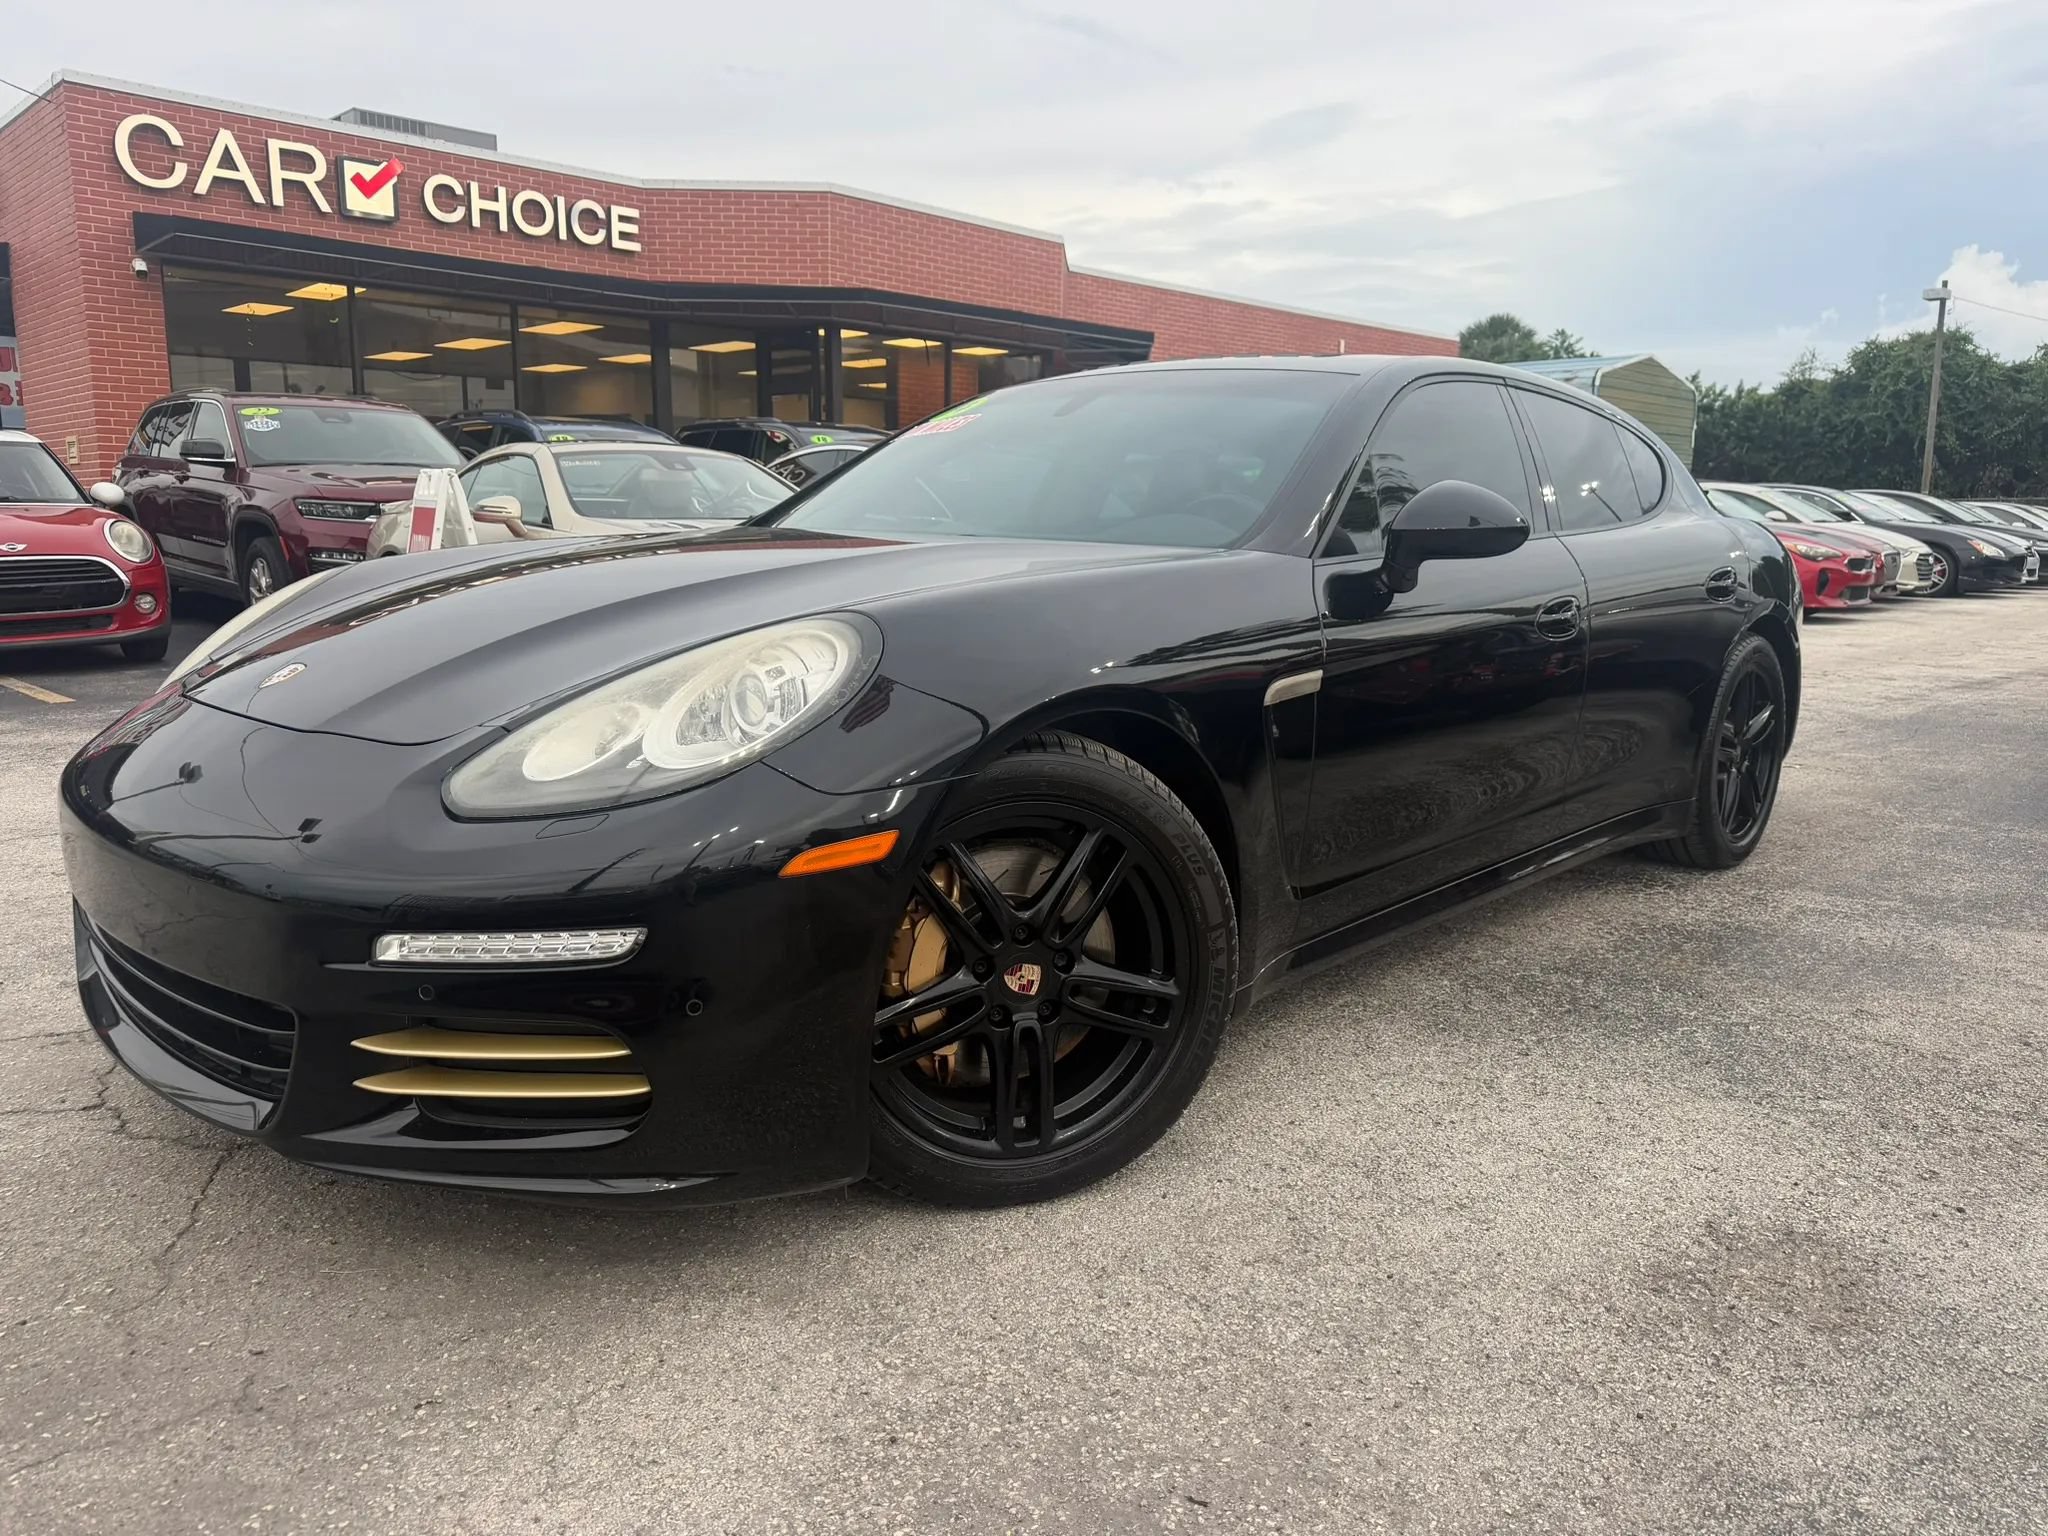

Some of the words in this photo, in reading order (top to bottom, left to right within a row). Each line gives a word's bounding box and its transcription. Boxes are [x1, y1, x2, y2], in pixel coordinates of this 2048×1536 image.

[114, 113, 333, 214] CAR
[423, 173, 642, 252] CHOICE
[1172, 832, 1206, 877] PLUS
